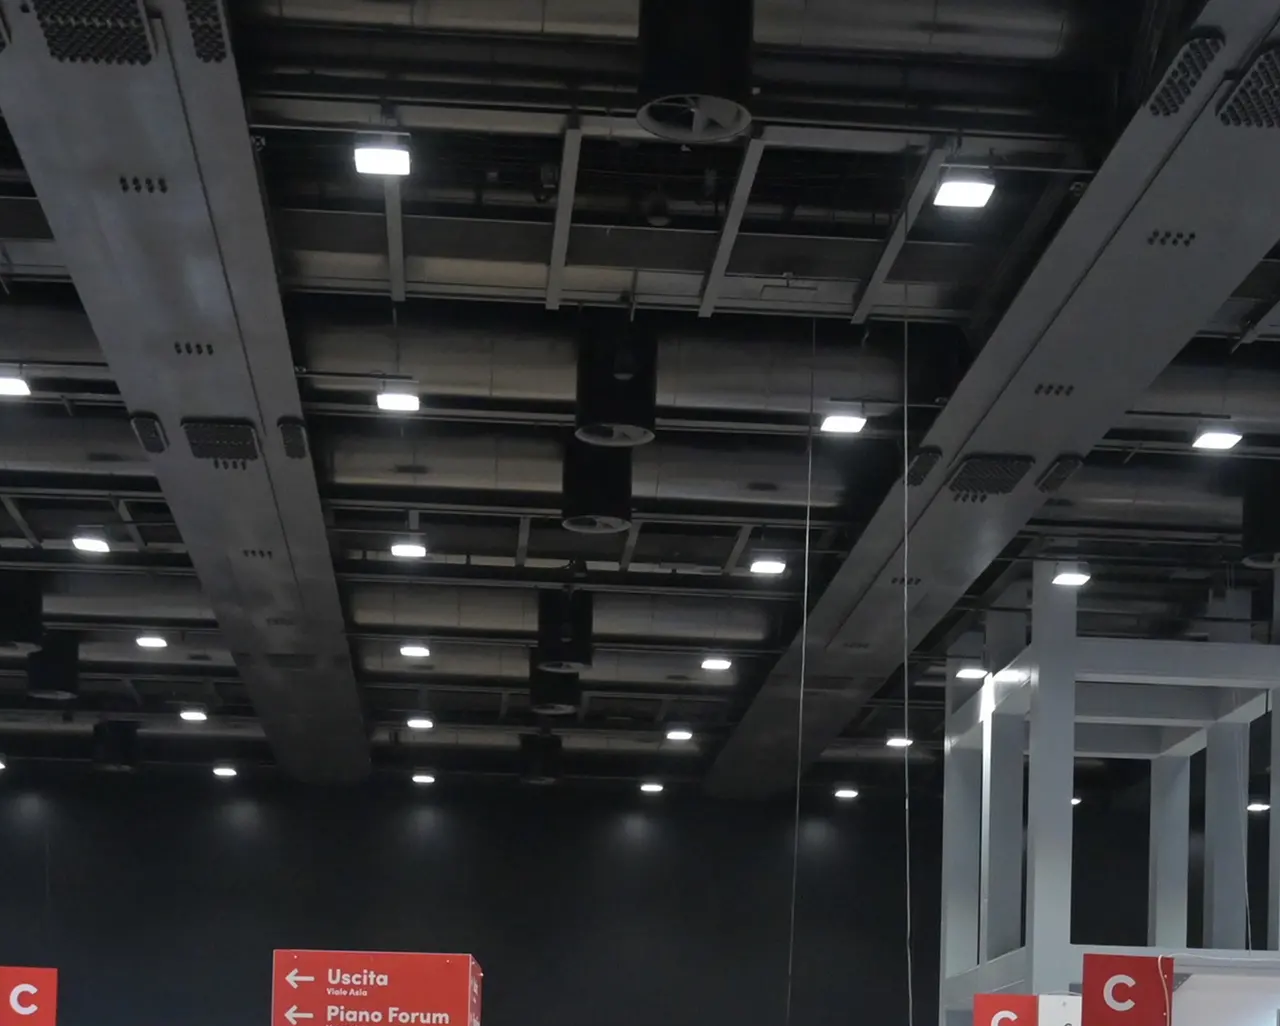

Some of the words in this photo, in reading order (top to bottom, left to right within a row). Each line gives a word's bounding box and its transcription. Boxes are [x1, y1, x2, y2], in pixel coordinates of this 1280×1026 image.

[328, 968, 388, 986] Uscita
[9, 983, 38, 1015] C
[326, 988, 348, 996] Viale
[349, 988, 368, 996] Asia
[1103, 974, 1136, 1012] C
[327, 1005, 383, 1023] Piano
[388, 1007, 450, 1024] Forum
